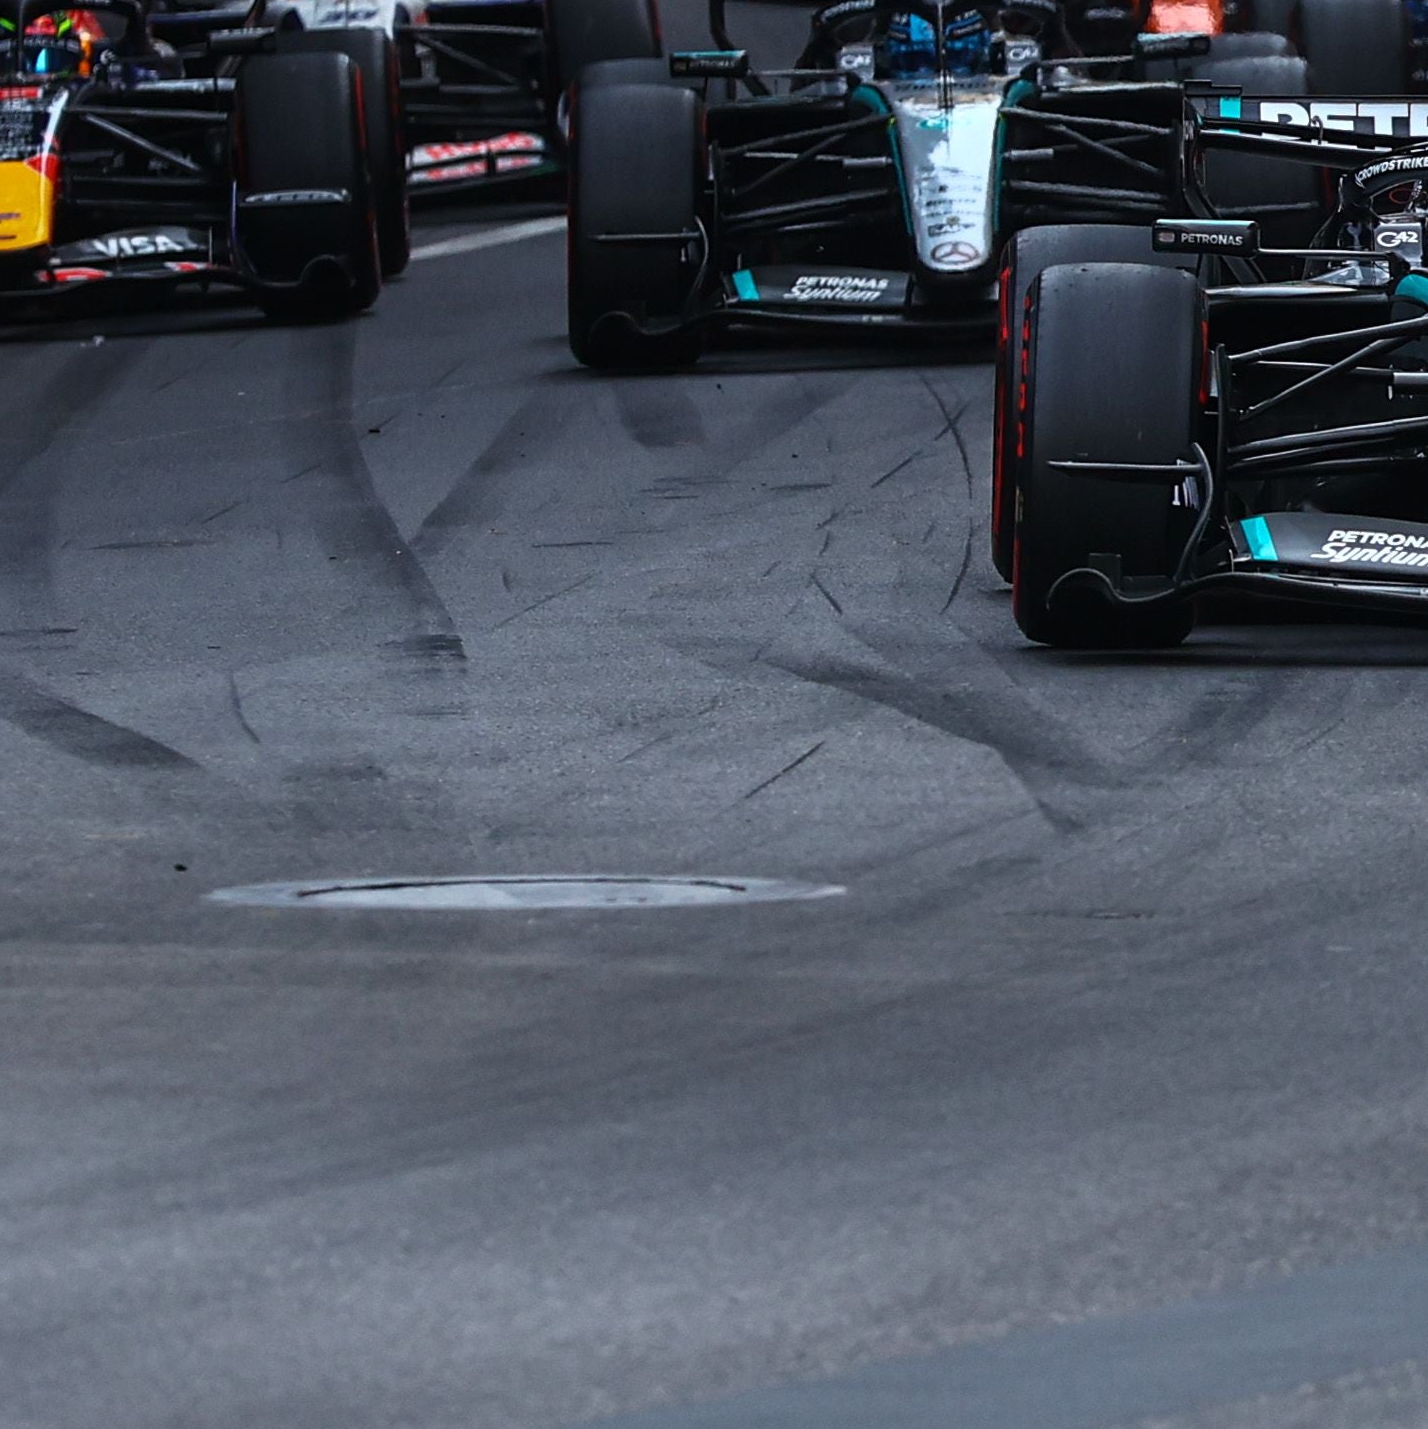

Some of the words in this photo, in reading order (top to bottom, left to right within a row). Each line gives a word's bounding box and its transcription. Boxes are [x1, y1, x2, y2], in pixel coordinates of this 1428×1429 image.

[93, 236, 184, 258] VISA
[1180, 232, 1244, 247] PETRONAS
[794, 275, 890, 291] PETRONAS
